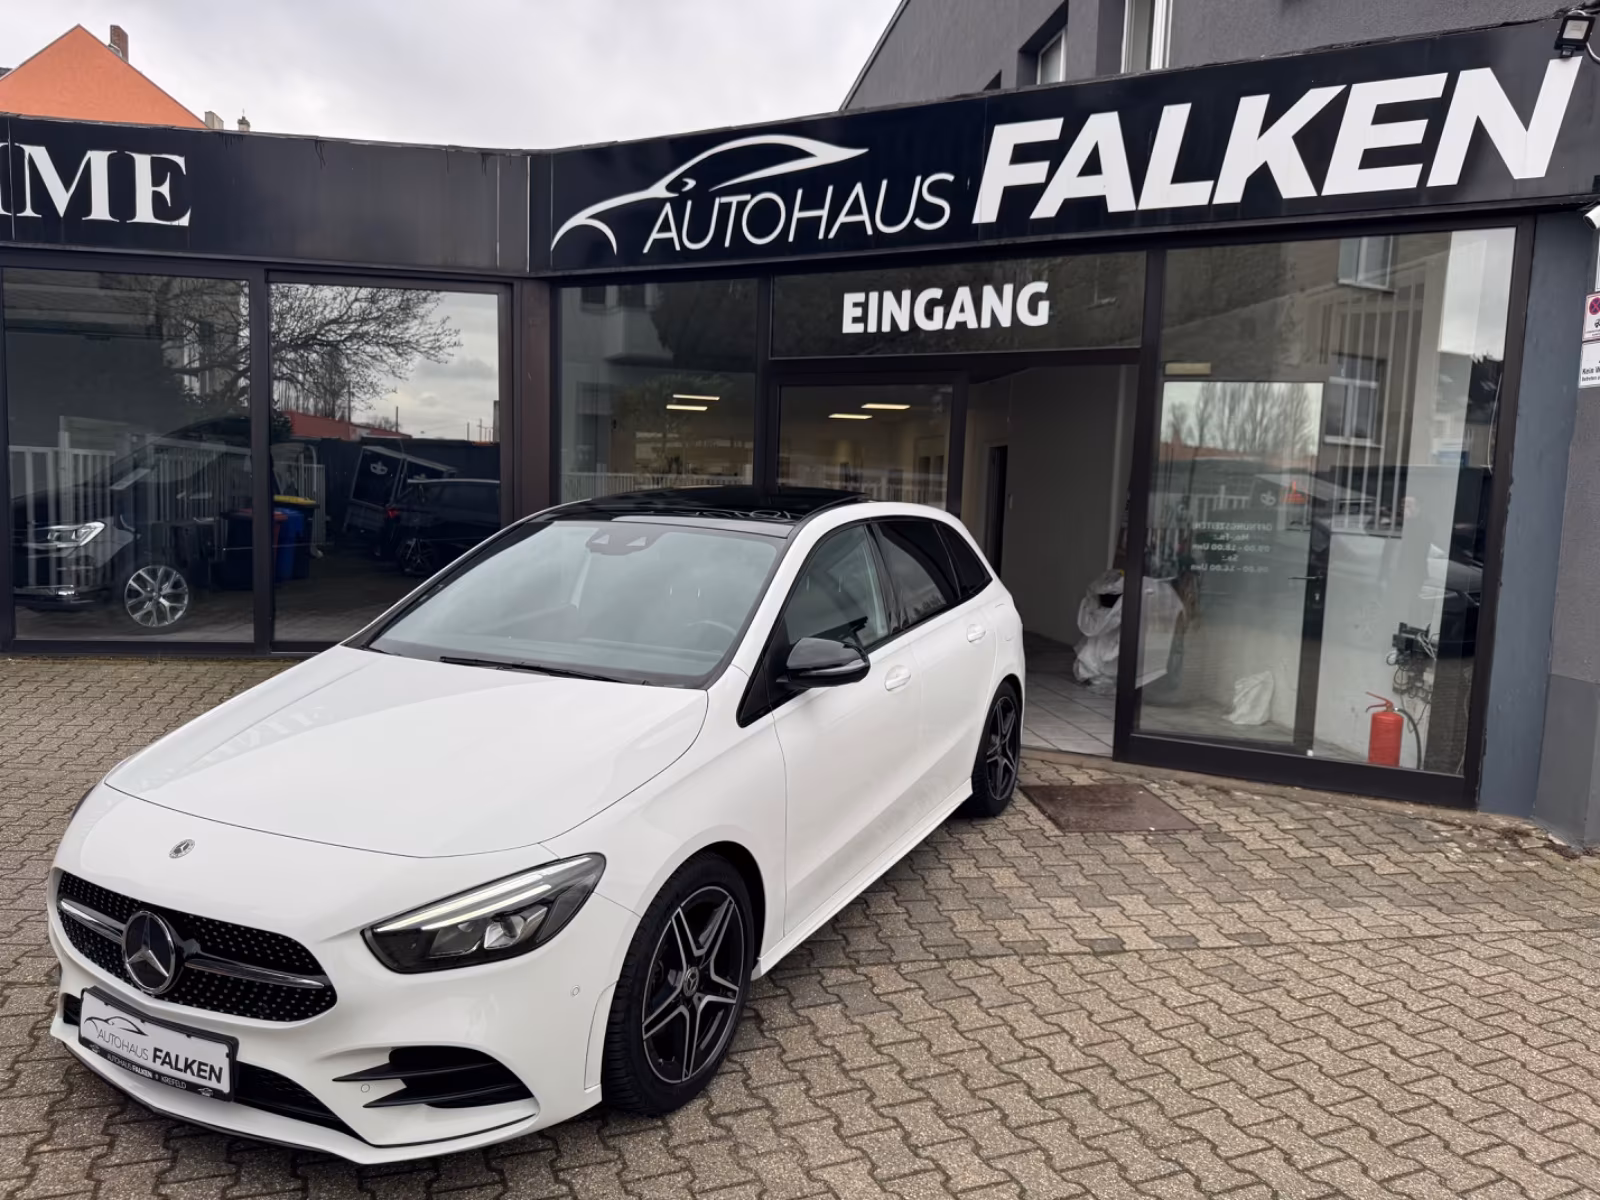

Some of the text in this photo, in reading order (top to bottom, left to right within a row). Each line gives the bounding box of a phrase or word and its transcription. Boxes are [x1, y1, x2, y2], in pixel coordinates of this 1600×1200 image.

[642, 56, 1583, 254] AUTOHAUS FALKEN
[841, 281, 1050, 334] EINGANG
[97, 1028, 223, 1084] AUTOHAUS FALKEN
[106, 1053, 187, 1090] AUTOHAUS FALKEN KREFELD
